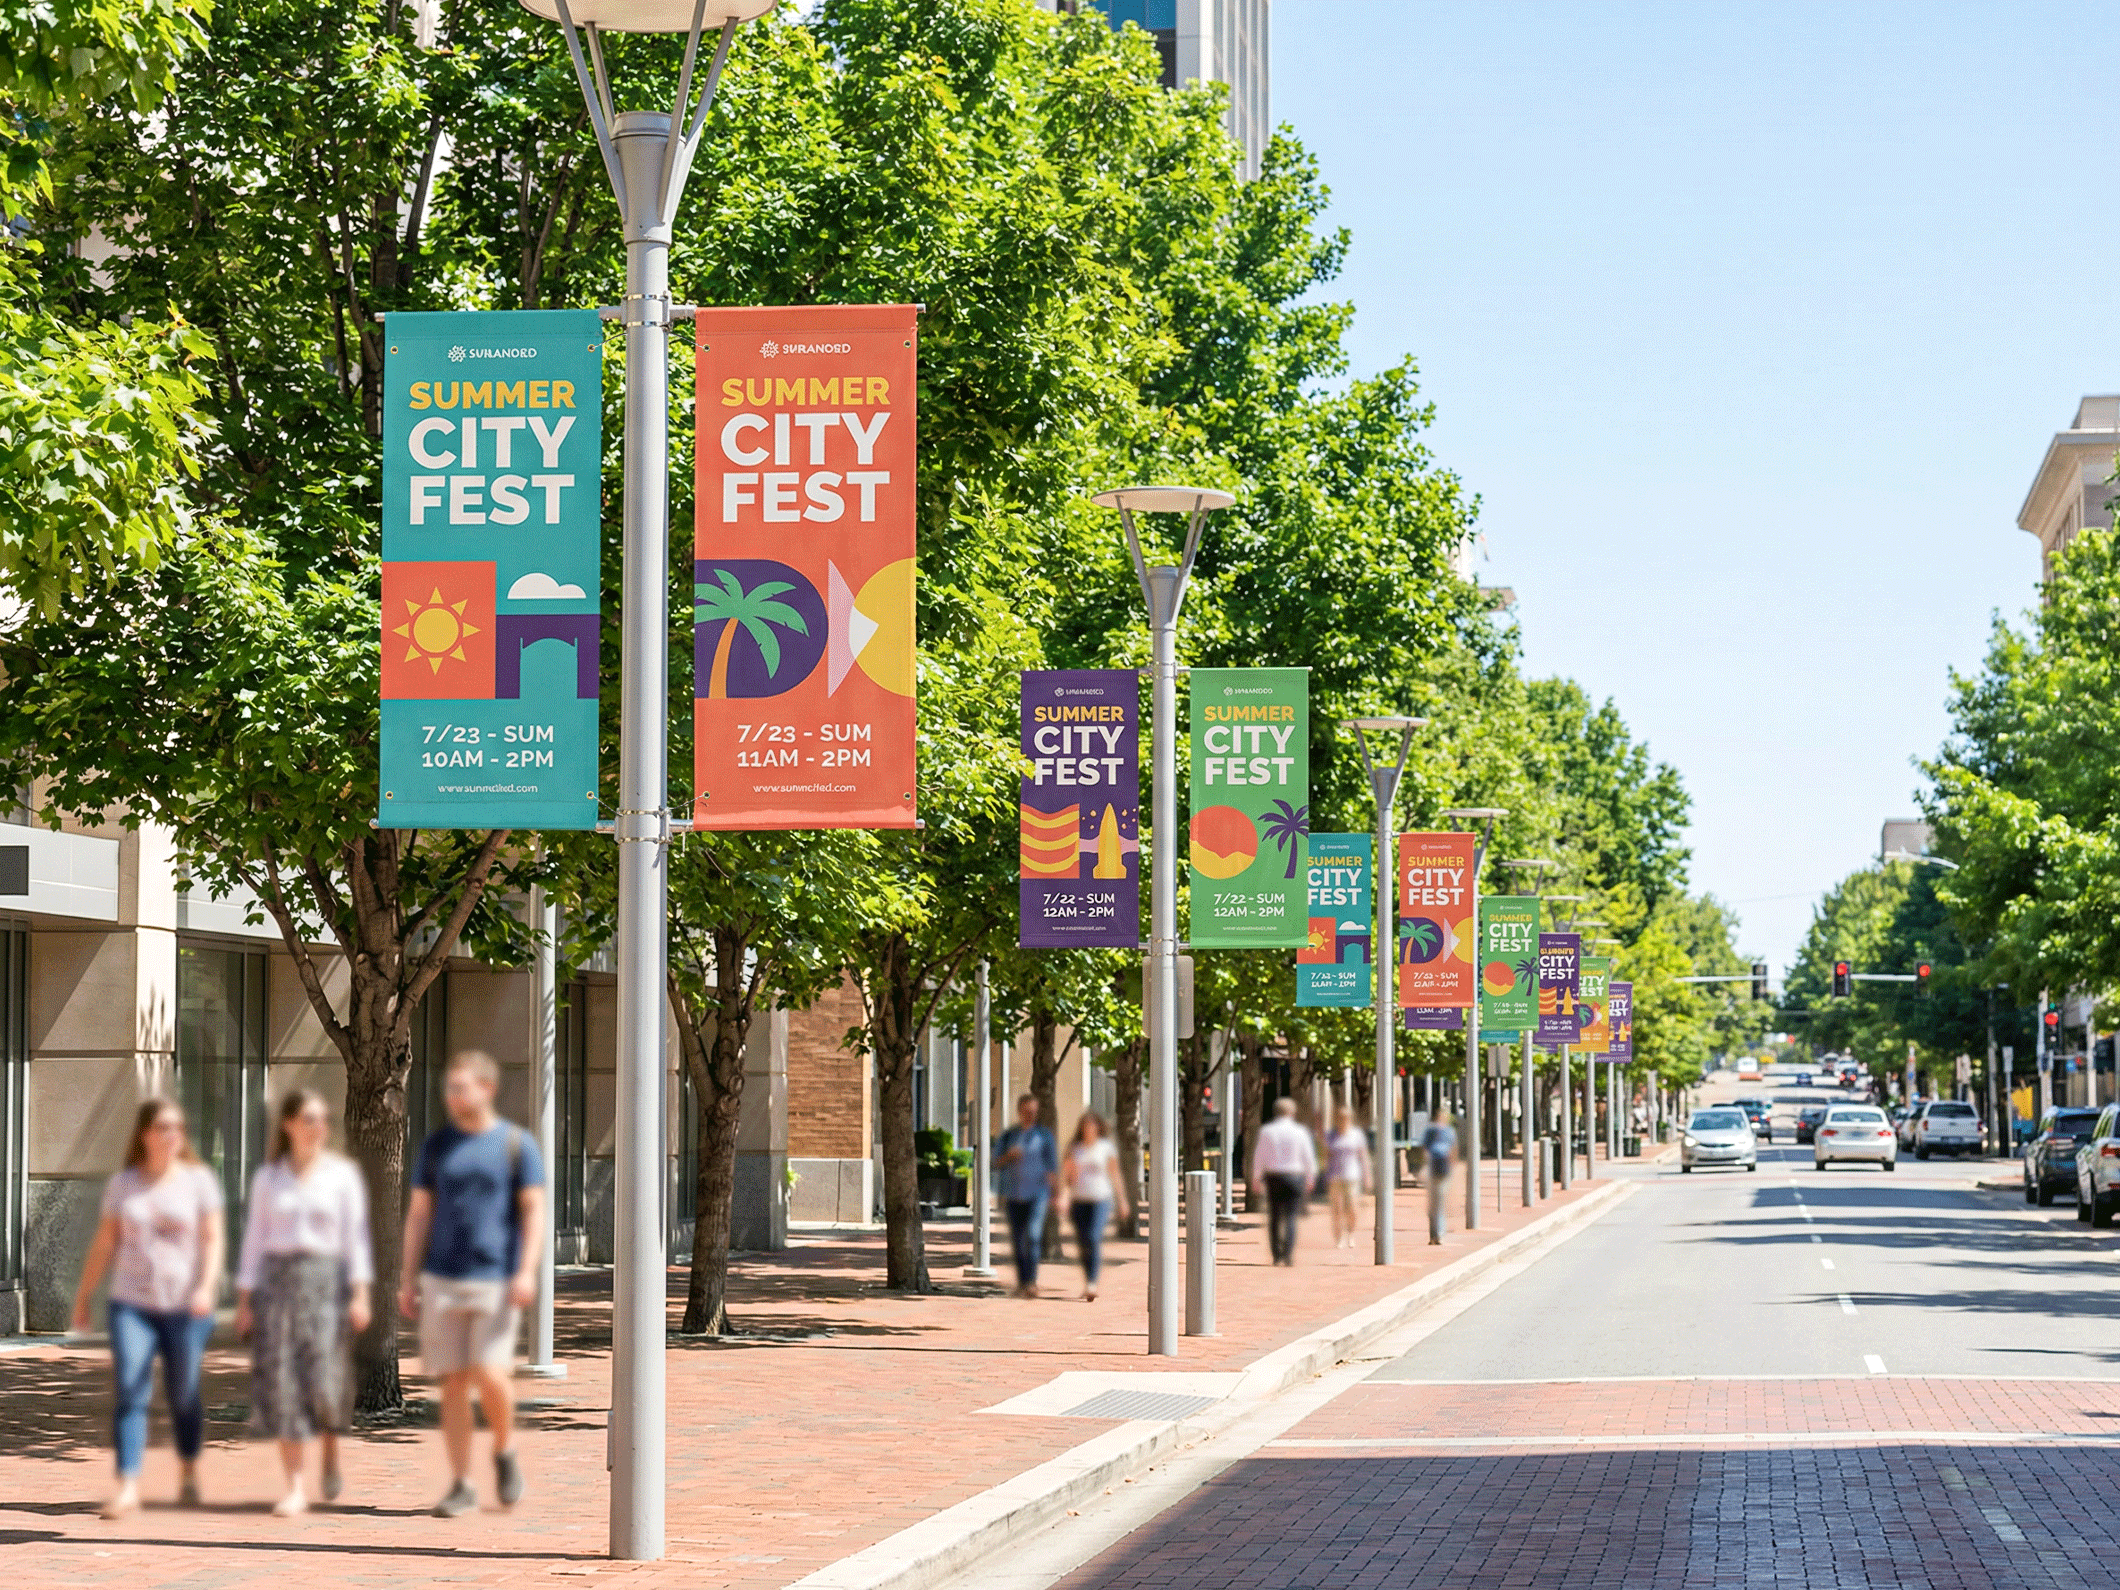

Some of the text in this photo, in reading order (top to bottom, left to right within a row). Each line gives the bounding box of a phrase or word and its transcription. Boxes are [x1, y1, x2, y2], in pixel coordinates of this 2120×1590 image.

[409, 380, 576, 410] SUMMER
[721, 377, 891, 407] SUMMER
[408, 416, 577, 470] CITY
[720, 412, 891, 466] CITY
[409, 474, 575, 525] FEST
[722, 471, 891, 523] FEST
[1034, 706, 1125, 722] SUMMER
[1204, 705, 1295, 722] SUMMER
[421, 724, 481, 744] 7/23
[504, 725, 554, 743] SUM
[737, 723, 796, 743] 7/23
[820, 723, 871, 742] SUM
[1034, 726, 1125, 754] CITY
[1203, 725, 1295, 754] CITY
[422, 750, 483, 768] 10AM
[506, 750, 554, 768] 2PM
[737, 749, 799, 767] 11AM
[821, 748, 871, 767] 2PM
[1034, 758, 1124, 785] FEST
[1205, 757, 1295, 785] FEST
[1307, 856, 1363, 867] SUMMER
[1408, 856, 1465, 867] SUMMER
[1308, 868, 1362, 886] CITY
[1407, 868, 1465, 887] CITY
[1043, 893, 1076, 905] 7/22
[1086, 893, 1115, 904] SUM
[1213, 893, 1246, 905] 7/22
[1256, 893, 1285, 904] SUM
[1308, 888, 1362, 905] FEST
[1408, 888, 1465, 906] FEST
[1043, 907, 1077, 918] 12AM
[1088, 906, 1115, 917] 2PM
[1214, 906, 1247, 917] 12AM
[1258, 906, 1285, 917] 2PM
[1489, 923, 1533, 938] CITY
[1490, 938, 1533, 952] FEST
[1539, 955, 1575, 968] CITY
[1539, 968, 1575, 980] FEST
